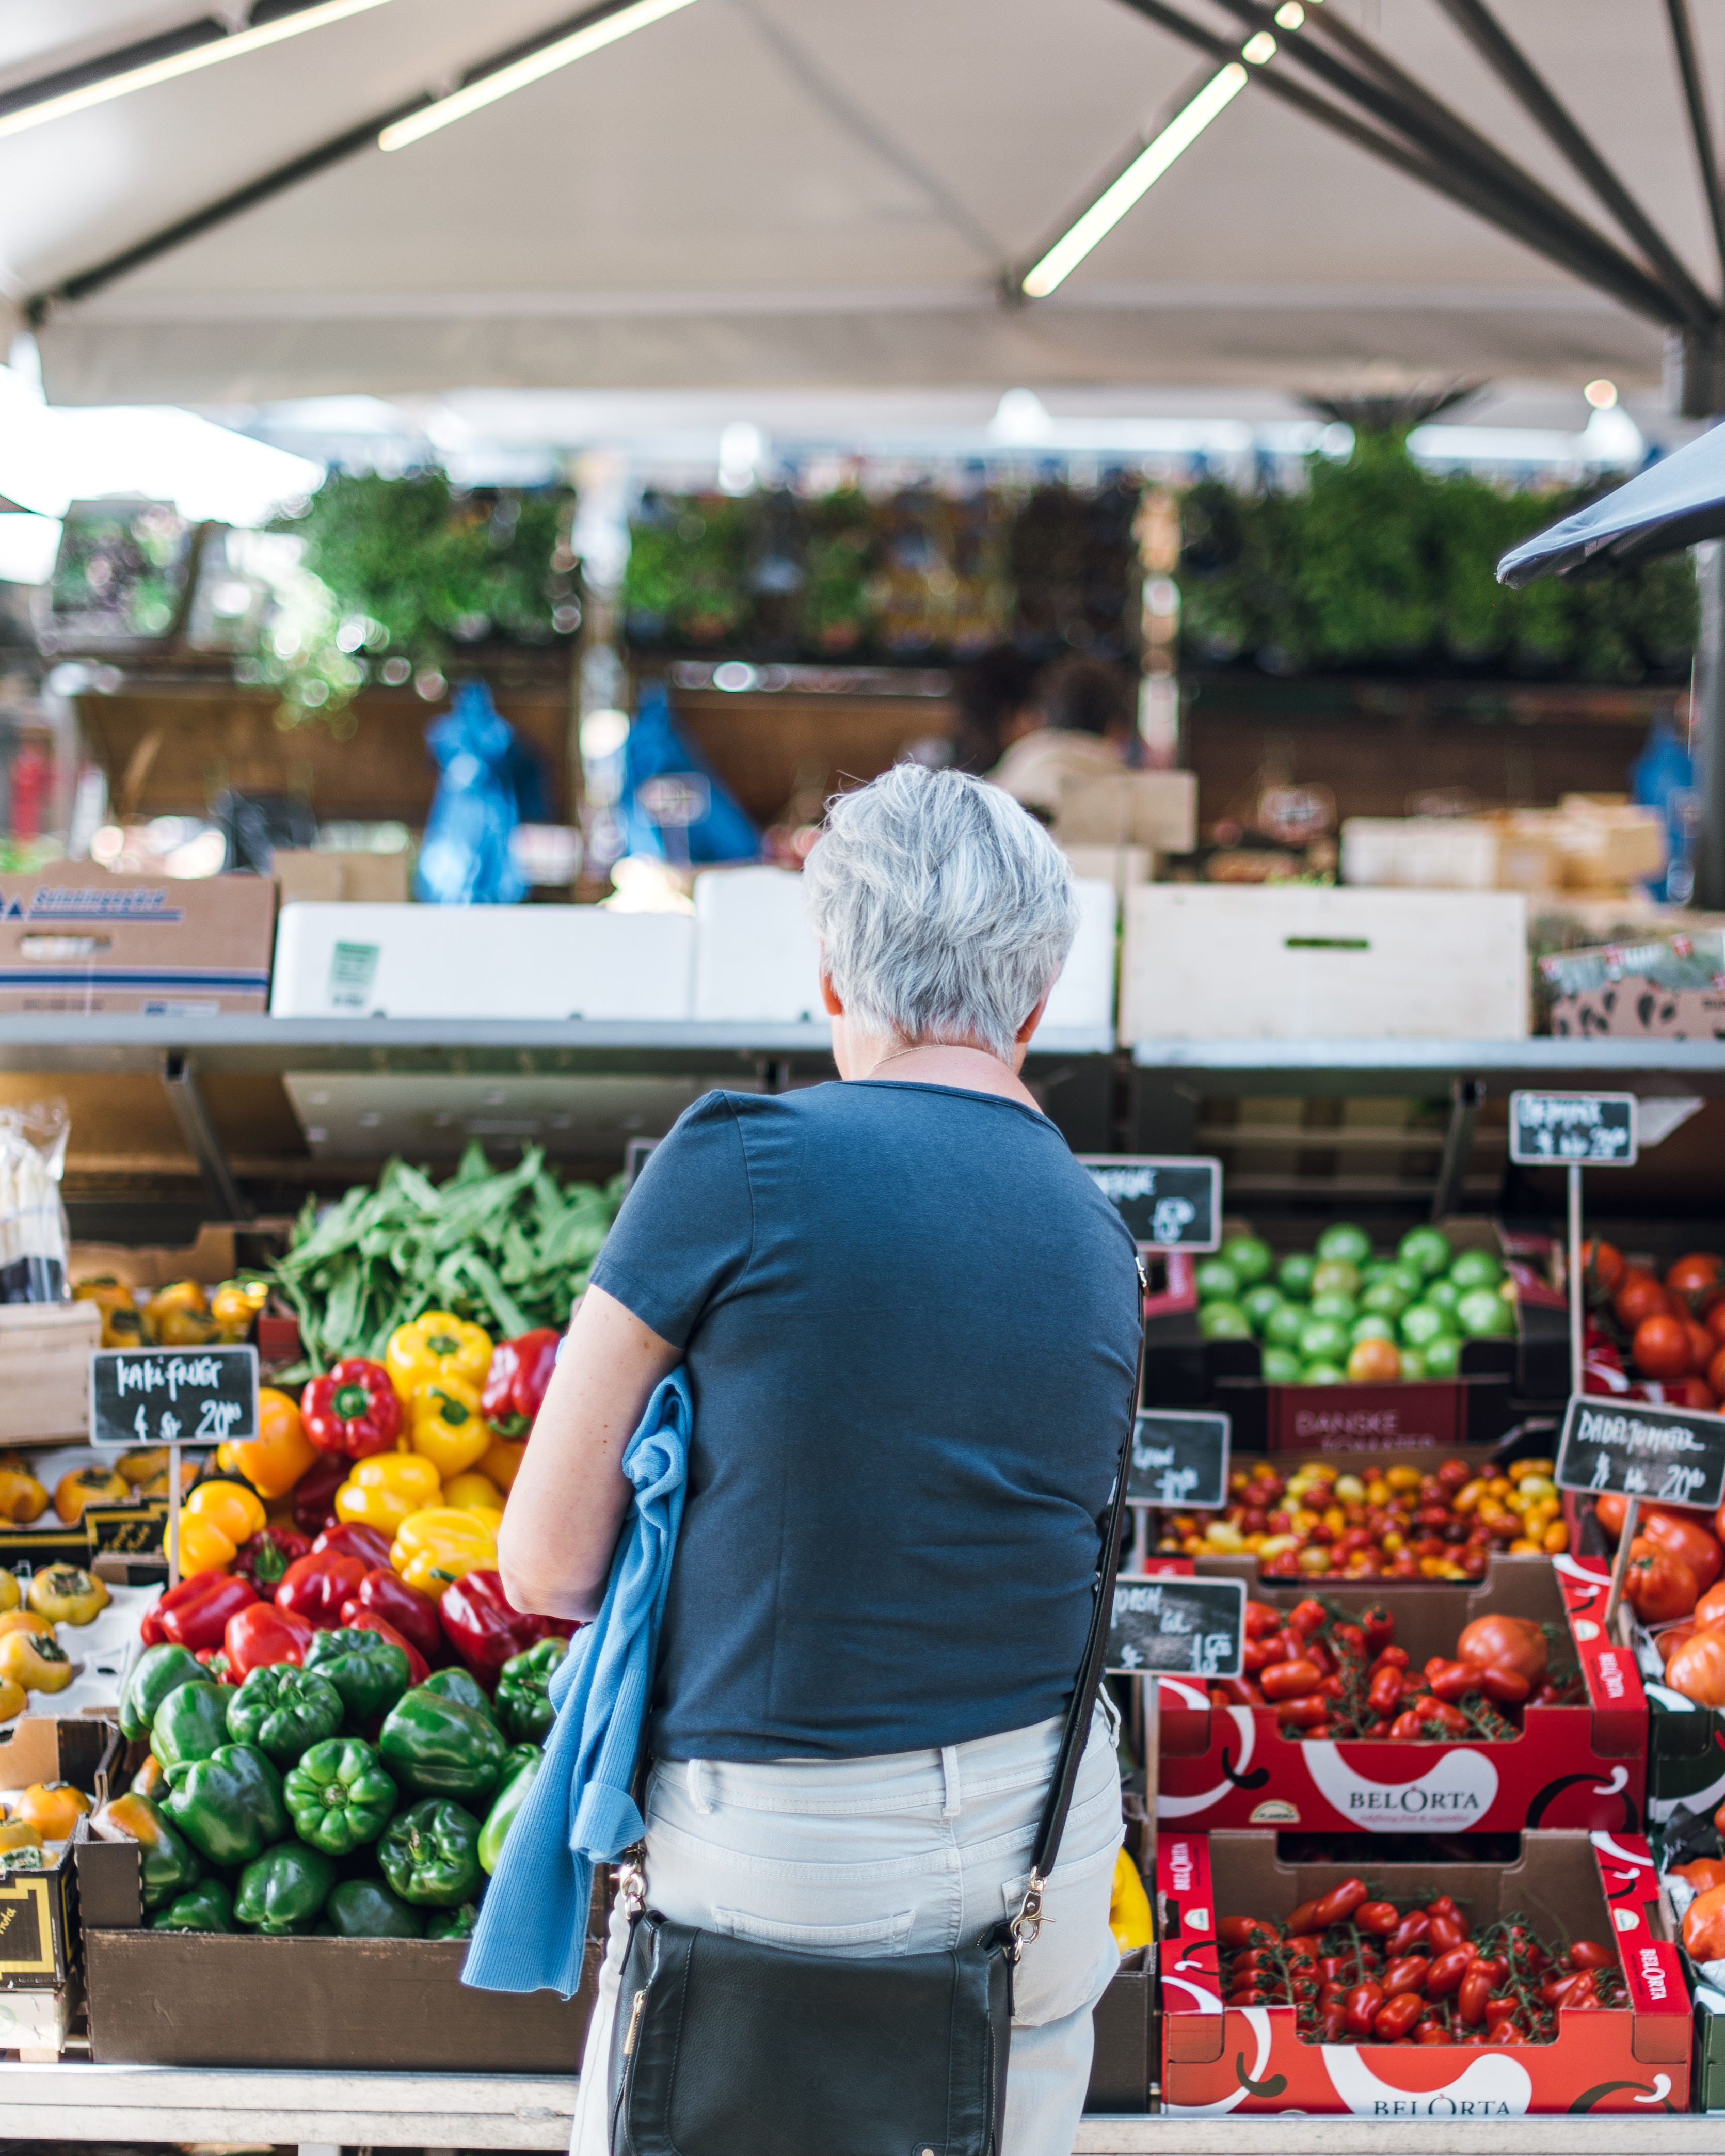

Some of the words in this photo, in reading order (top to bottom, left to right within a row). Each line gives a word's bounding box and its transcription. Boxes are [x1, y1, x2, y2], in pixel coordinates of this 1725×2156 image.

[1350, 1787, 1480, 1813] BELORTA
[1170, 1842, 1193, 1890] BELORTA
[1639, 1948, 1667, 2000] BELORTA
